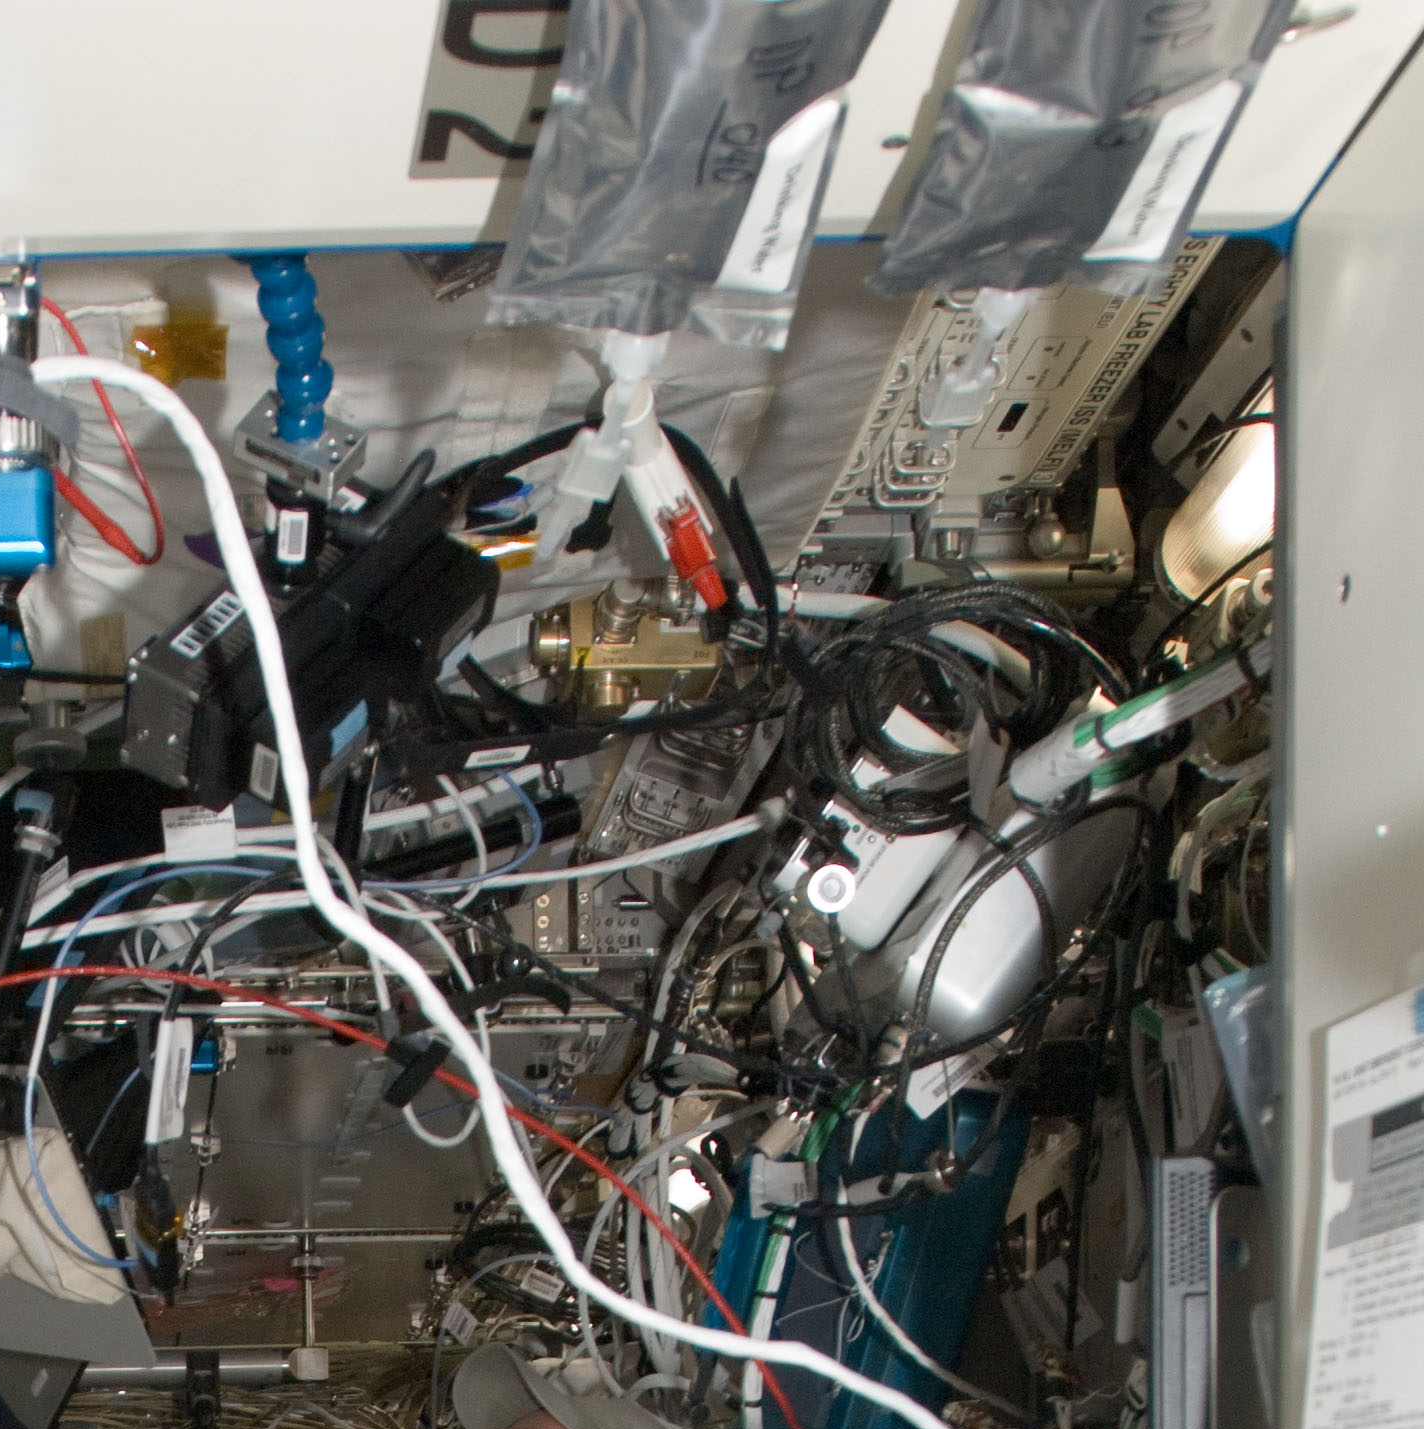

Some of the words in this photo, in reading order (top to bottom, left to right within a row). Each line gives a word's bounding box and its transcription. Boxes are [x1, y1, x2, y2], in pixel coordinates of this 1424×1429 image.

[1147, 253, 1197, 309] EIGHTY
[1125, 311, 1161, 340] LAB
[1086, 342, 1139, 403] FREEZER
[1068, 403, 1100, 426] ISS
